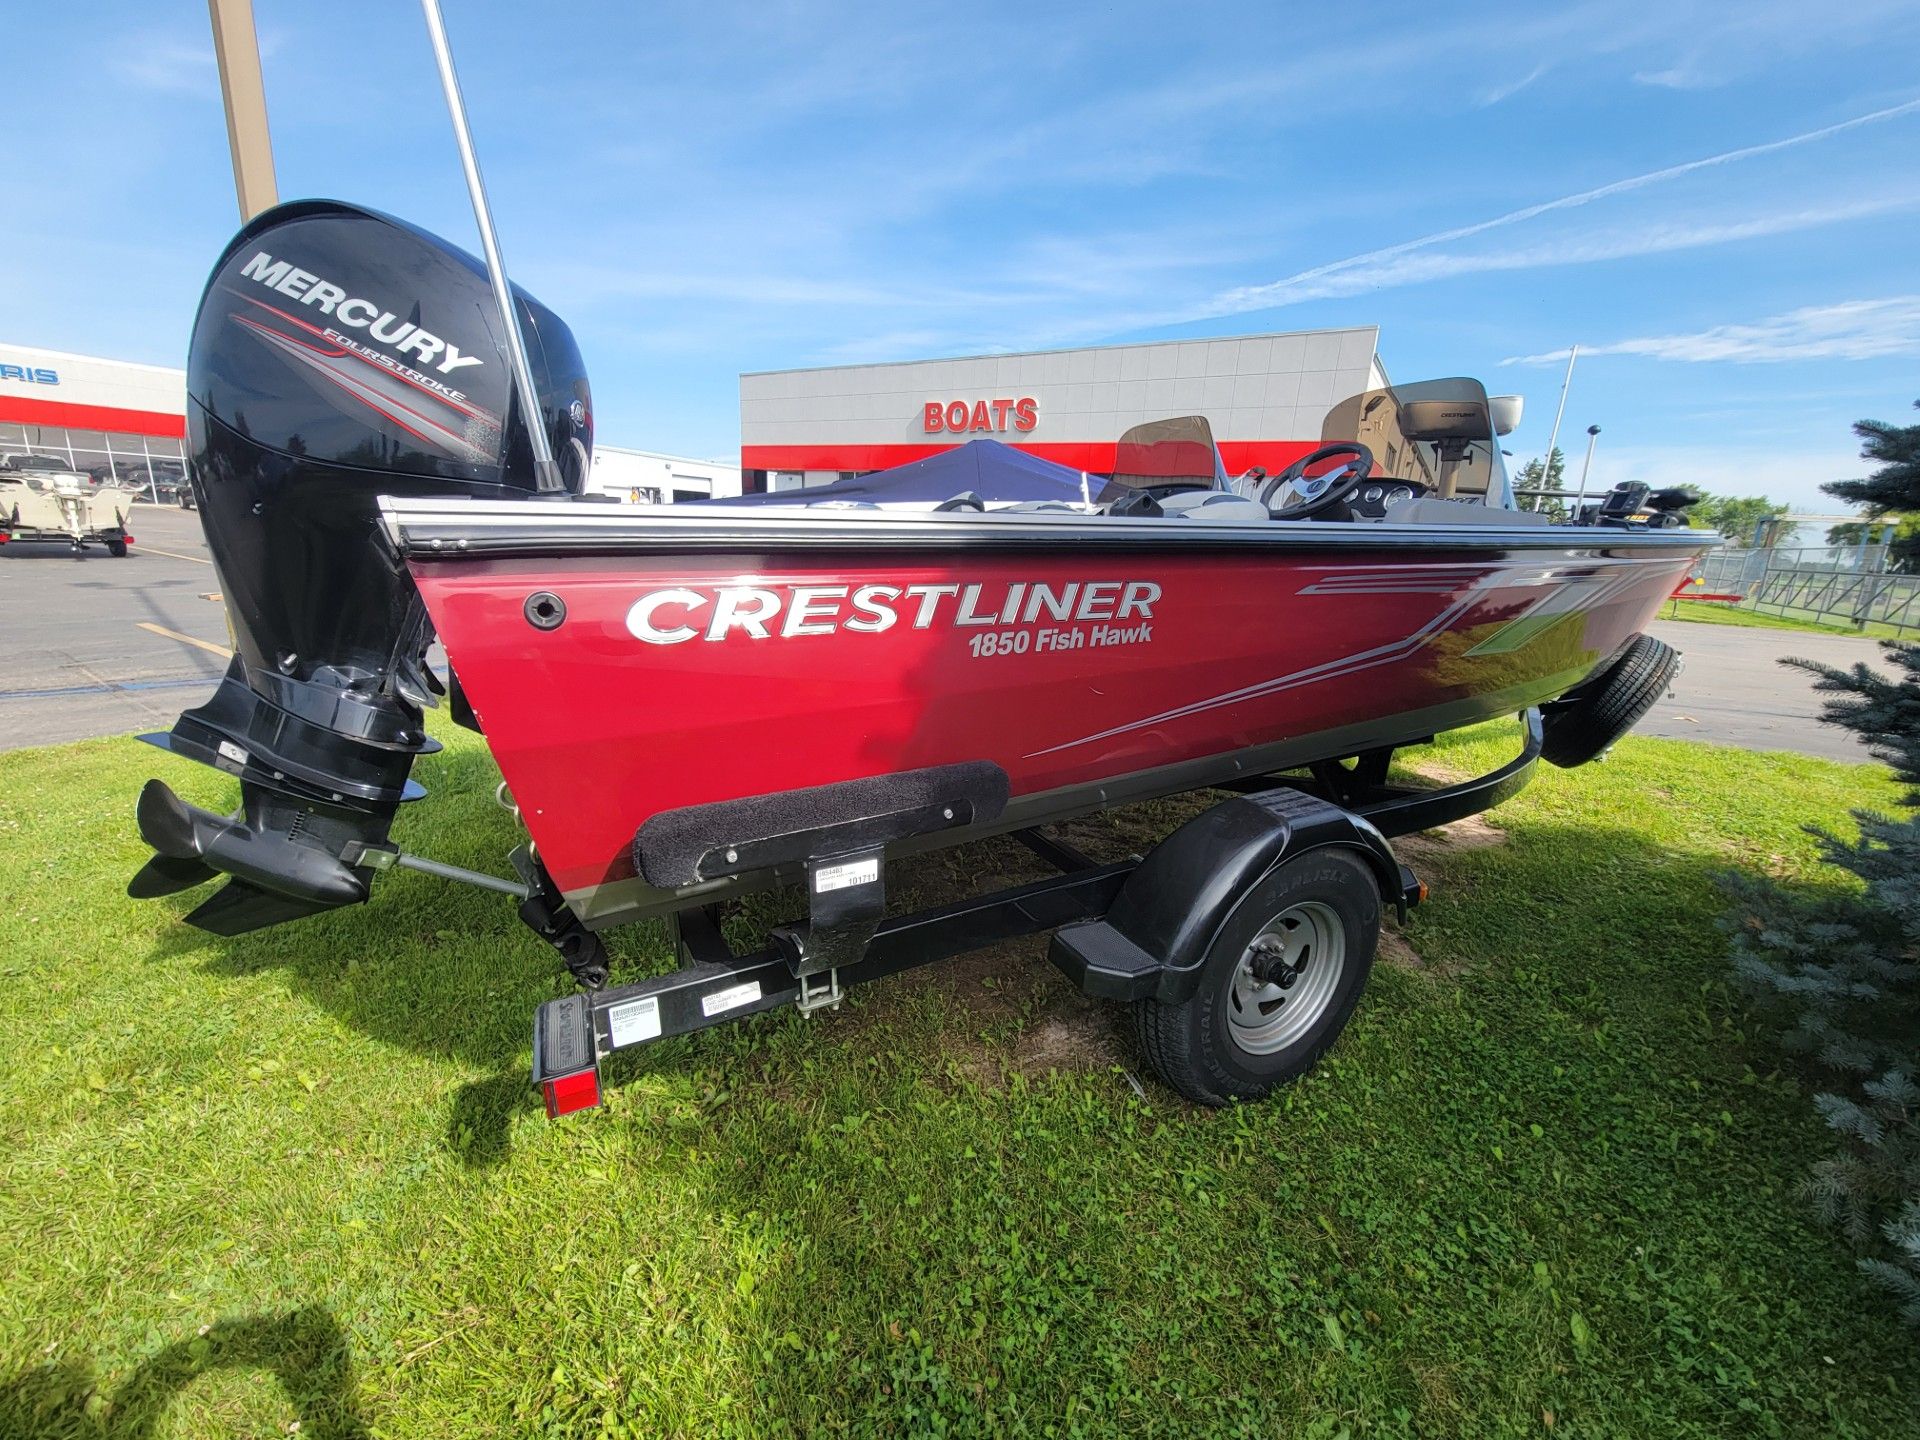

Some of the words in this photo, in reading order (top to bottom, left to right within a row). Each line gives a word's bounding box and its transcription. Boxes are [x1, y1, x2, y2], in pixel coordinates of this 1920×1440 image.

[240, 251, 484, 374] MERCURY
[0, 364, 59, 385] RIS
[321, 327, 467, 402] FOURSTROKE
[924, 397, 1040, 433] BOATS
[625, 579, 1163, 645] CRESTLINER
[968, 630, 1030, 658] 1850
[1034, 627, 1085, 653] Fish
[1089, 621, 1154, 648] Hawk
